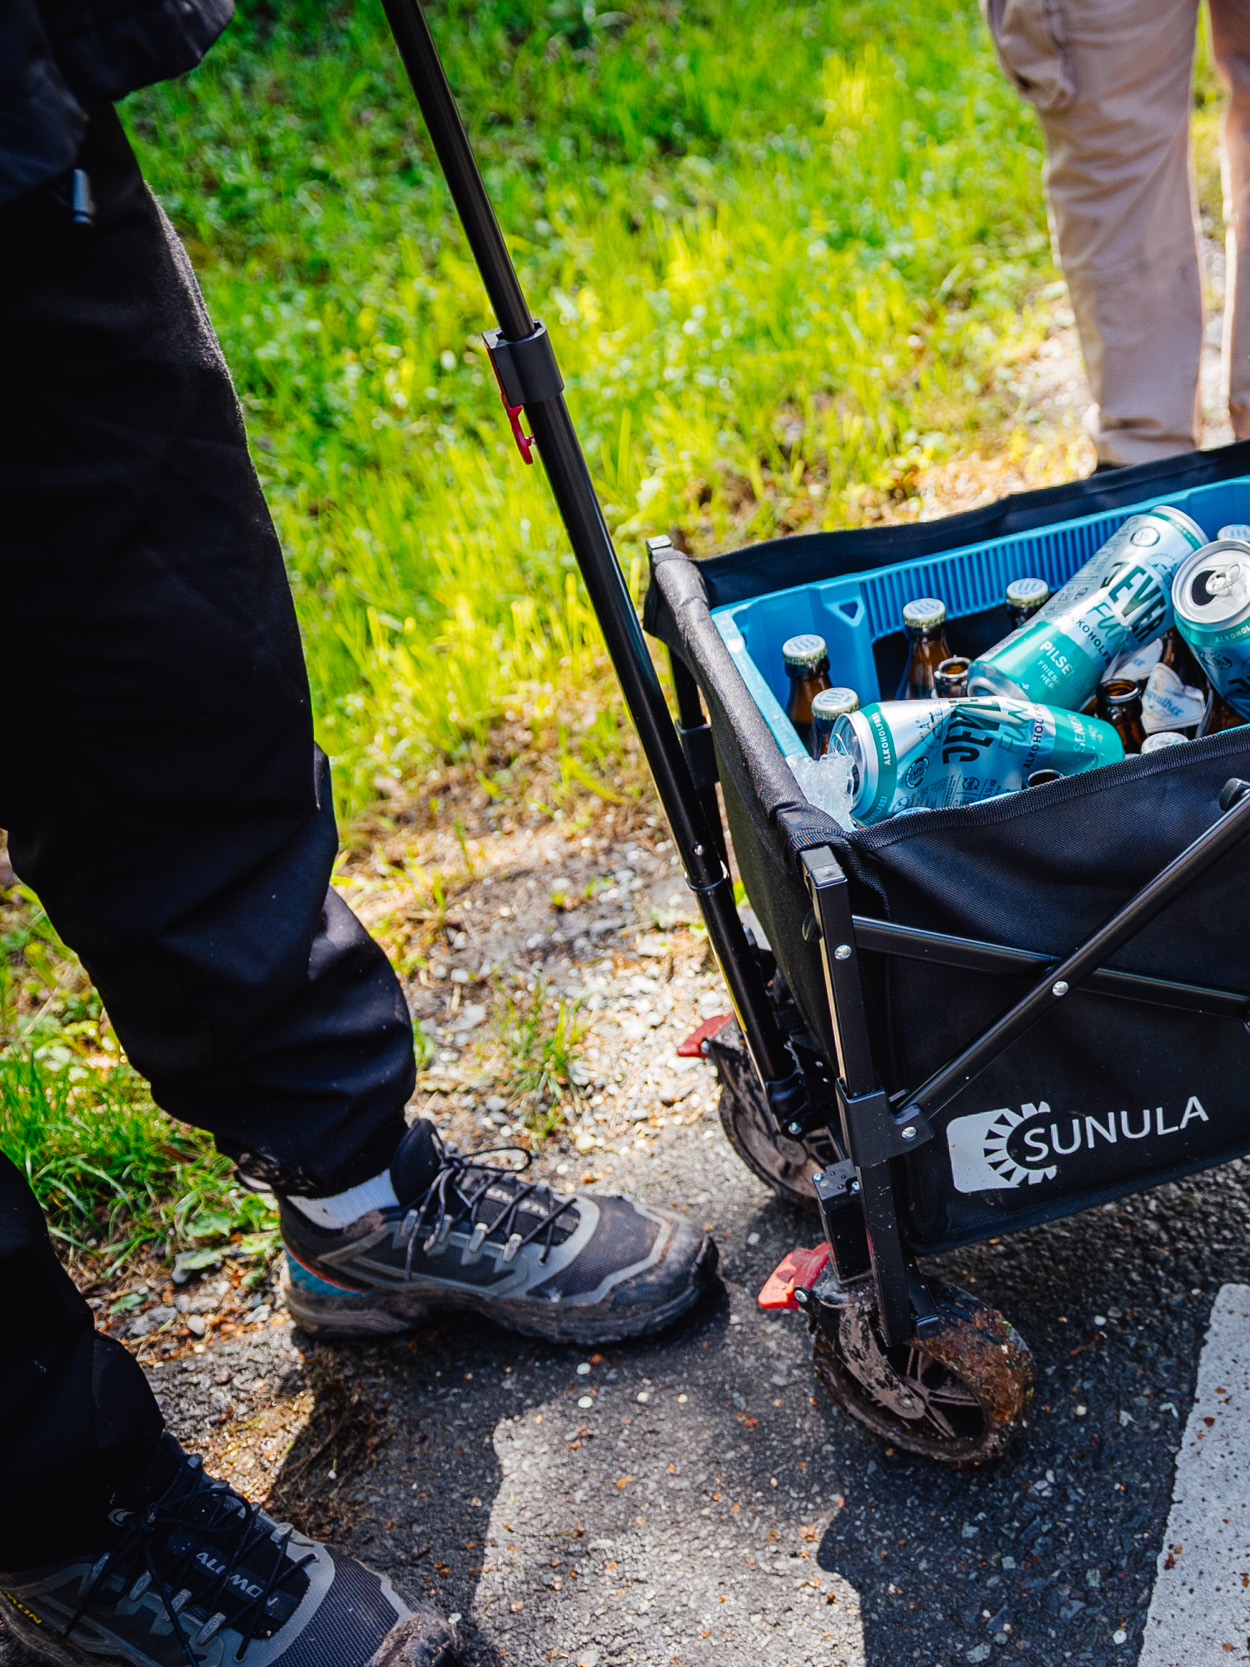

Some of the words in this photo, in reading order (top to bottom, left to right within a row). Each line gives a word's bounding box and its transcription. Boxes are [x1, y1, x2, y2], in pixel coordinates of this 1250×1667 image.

[1100, 561, 1166, 642] JEVER
[870, 711, 892, 766] ALKOHOLFREI
[1067, 713, 1087, 753] SENER
[1023, 1095, 1210, 1162] SUNULA
